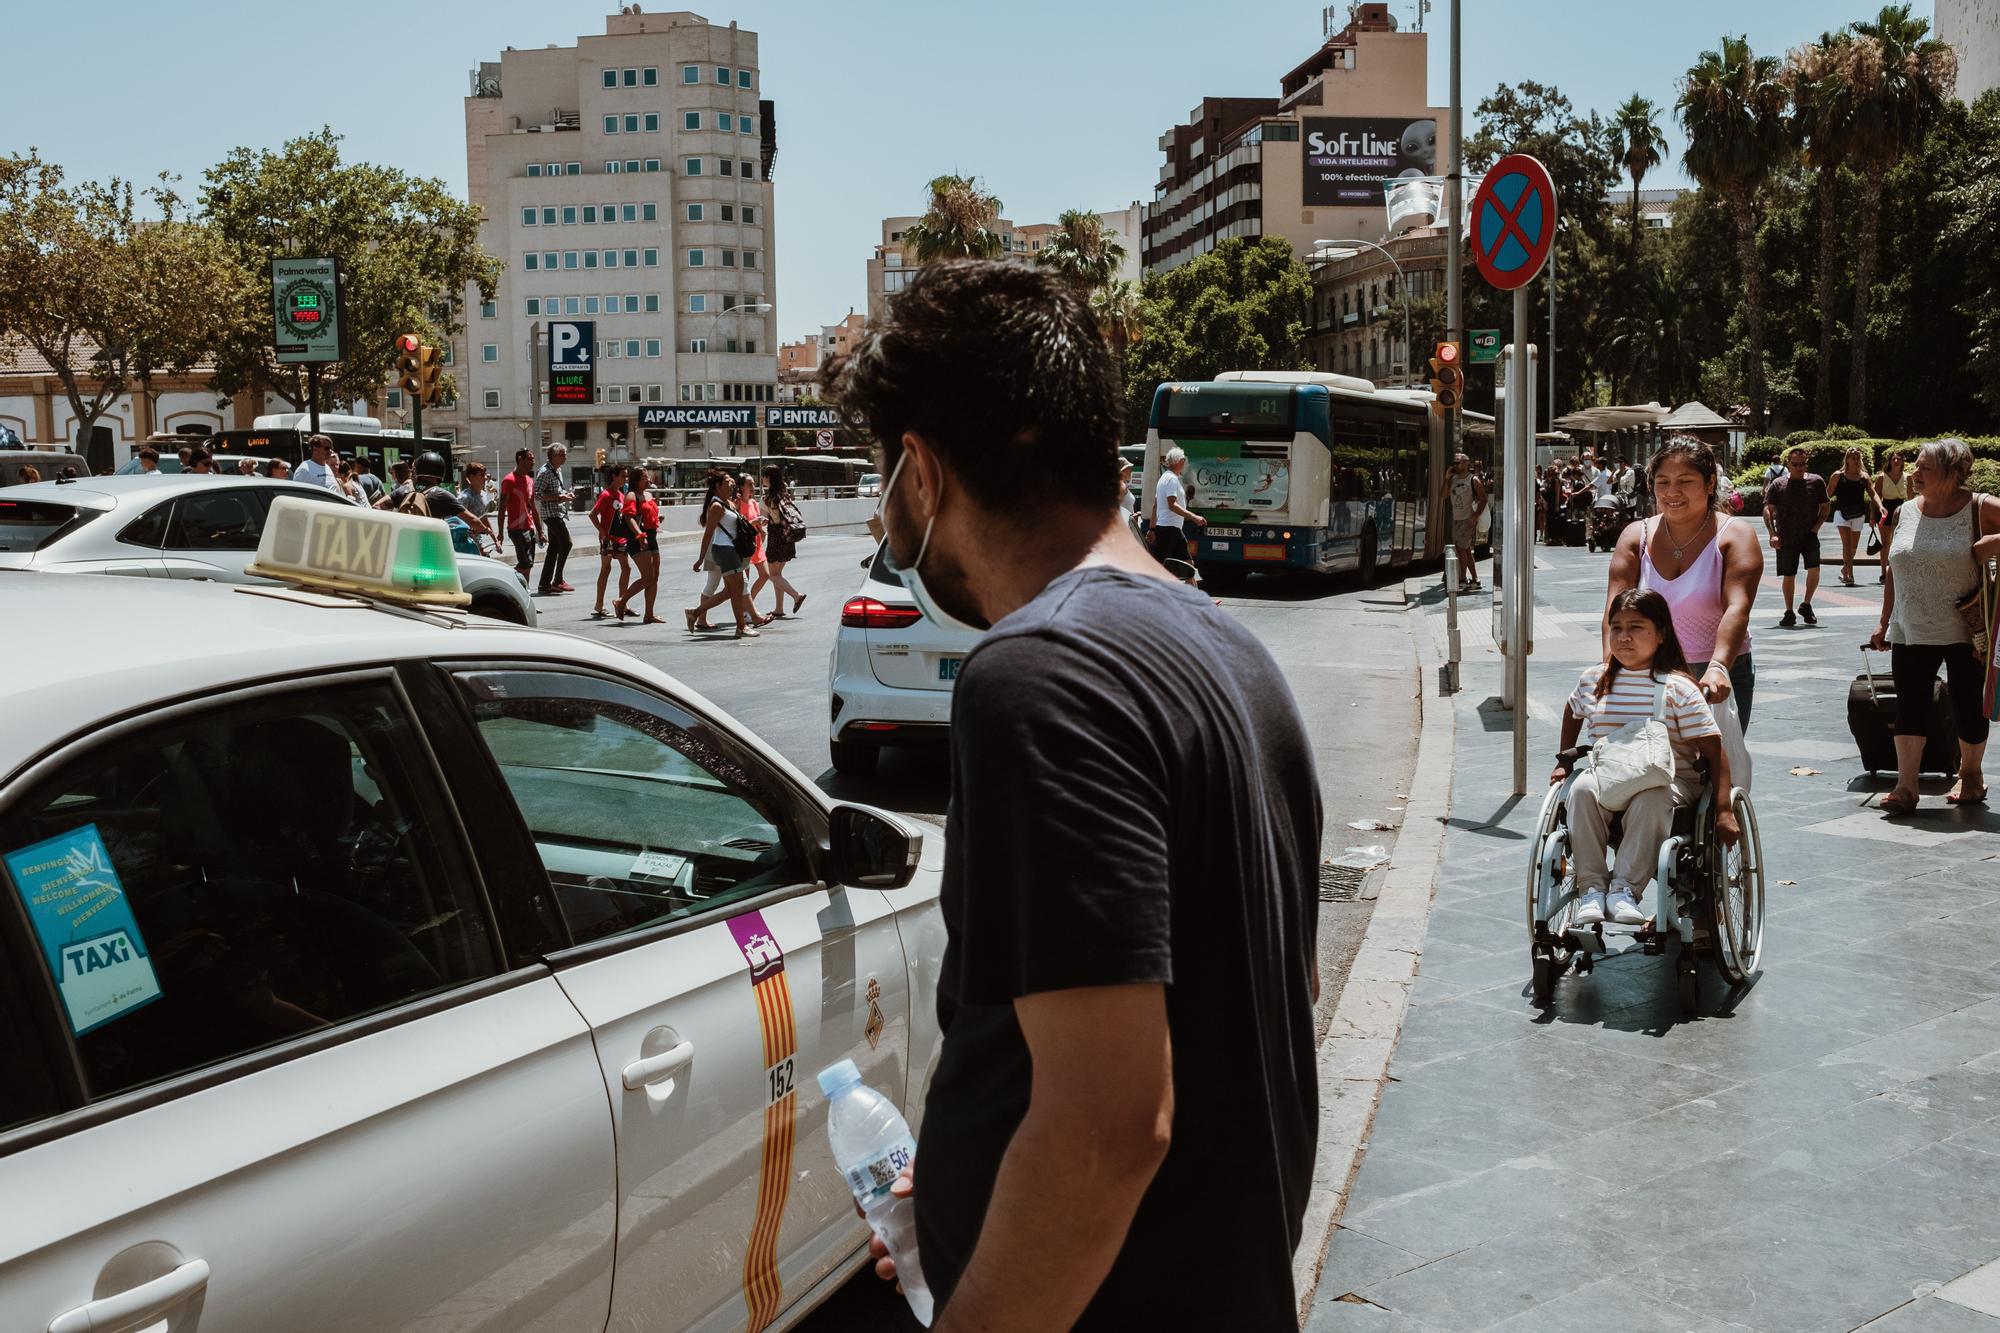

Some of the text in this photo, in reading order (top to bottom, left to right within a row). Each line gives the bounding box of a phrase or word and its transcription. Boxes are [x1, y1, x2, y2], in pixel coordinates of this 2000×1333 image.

[1320, 173, 1343, 181] 100%
[278, 266, 304, 276] Palma
[552, 323, 580, 363] P
[644, 410, 750, 423] APARCAMENT
[784, 410, 843, 424] ENTRAD
[315, 514, 390, 577] TAXI
[32, 886, 79, 905] WELCOME
[57, 882, 113, 916] WILLKOMMEN
[72, 891, 119, 928] BIENVENUE
[769, 1058, 794, 1103] 152
